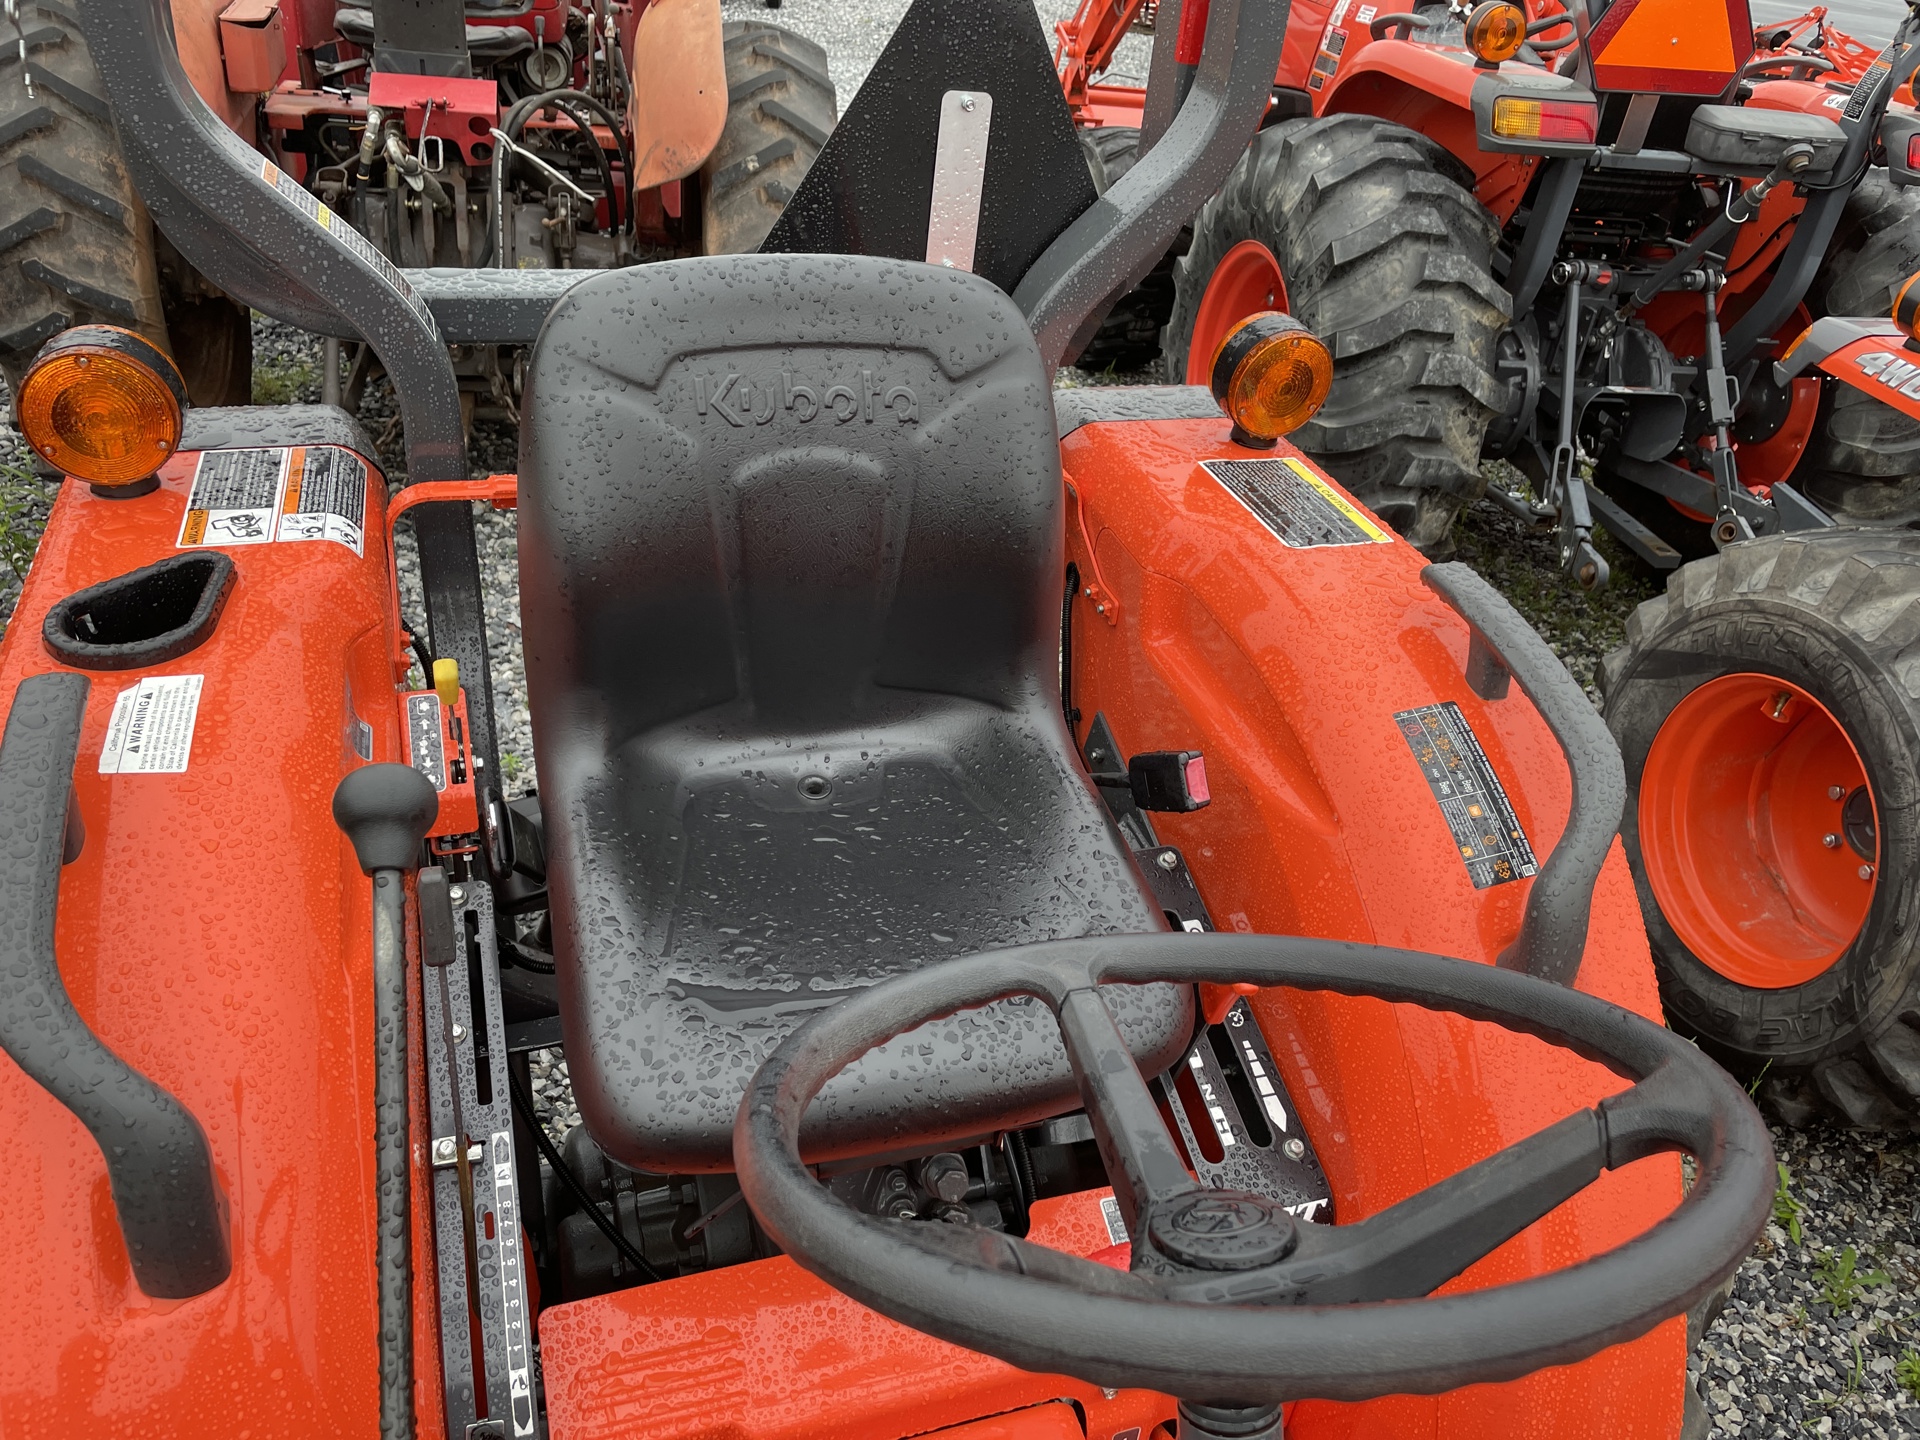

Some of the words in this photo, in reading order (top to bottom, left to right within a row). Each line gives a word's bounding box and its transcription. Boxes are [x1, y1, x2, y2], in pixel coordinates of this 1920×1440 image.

[693, 369, 921, 427] Kubota
[1321, 488, 1353, 514] CAUTION
[188, 510, 204, 539] WARNING
[1692, 620, 1852, 684] TITAN
[129, 701, 151, 743] WARNING
[1430, 768, 1441, 778] AND
[1455, 770, 1466, 780] AND
[1435, 780, 1455, 795] Beep
[1458, 779, 1477, 793] Beep
[1201, 1083, 1216, 1101] N
[1215, 1117, 1230, 1135] H
[506, 1238, 515, 1246] 6
[507, 1258, 516, 1266] 5
[509, 1278, 518, 1287] 4
[510, 1299, 519, 1307] 3
[511, 1320, 521, 1329] 2
[513, 1343, 523, 1353] 1
